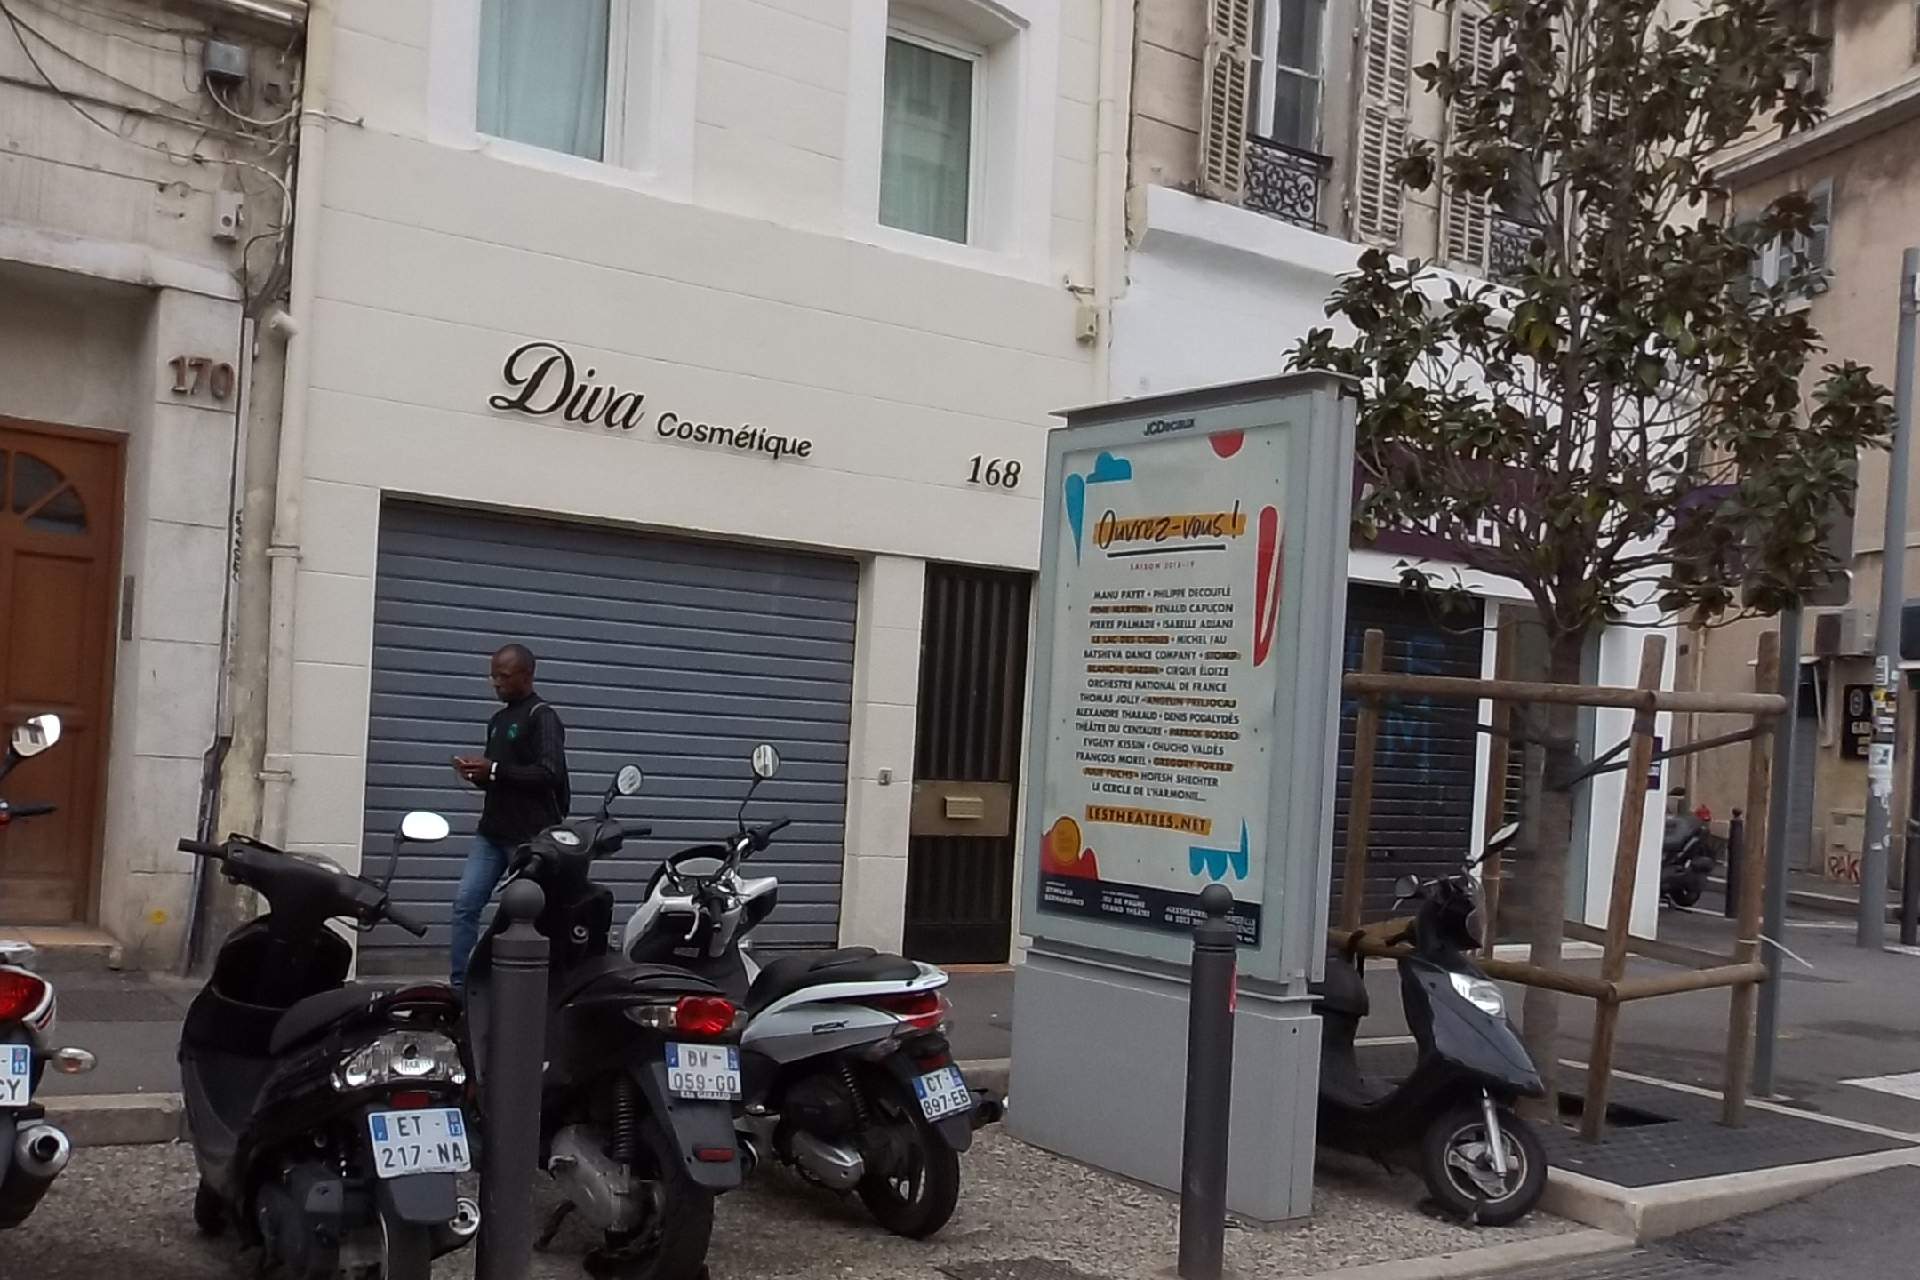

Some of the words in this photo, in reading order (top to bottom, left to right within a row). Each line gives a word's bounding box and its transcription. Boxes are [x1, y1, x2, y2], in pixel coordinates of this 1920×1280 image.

[169, 356, 235, 399] 170
[489, 342, 644, 429] Diva
[656, 412, 812, 460] Cosmétique
[966, 455, 1021, 488] 168
[1093, 590, 1119, 600] MANU
[1125, 651, 1152, 660] DANCE
[1155, 651, 1197, 661] COMPANY
[1087, 678, 1133, 690] ORCHESTRE
[1135, 680, 1177, 692] NATIONAL
[1179, 682, 1190, 692] DE
[1192, 682, 1227, 693] FRANCE
[1080, 693, 1113, 704] THOMAS
[1075, 707, 1120, 719] ALEXANDRE
[1108, 723, 1121, 733] DU
[1102, 782, 1131, 795] CERCLE
[1133, 786, 1144, 796] DE
